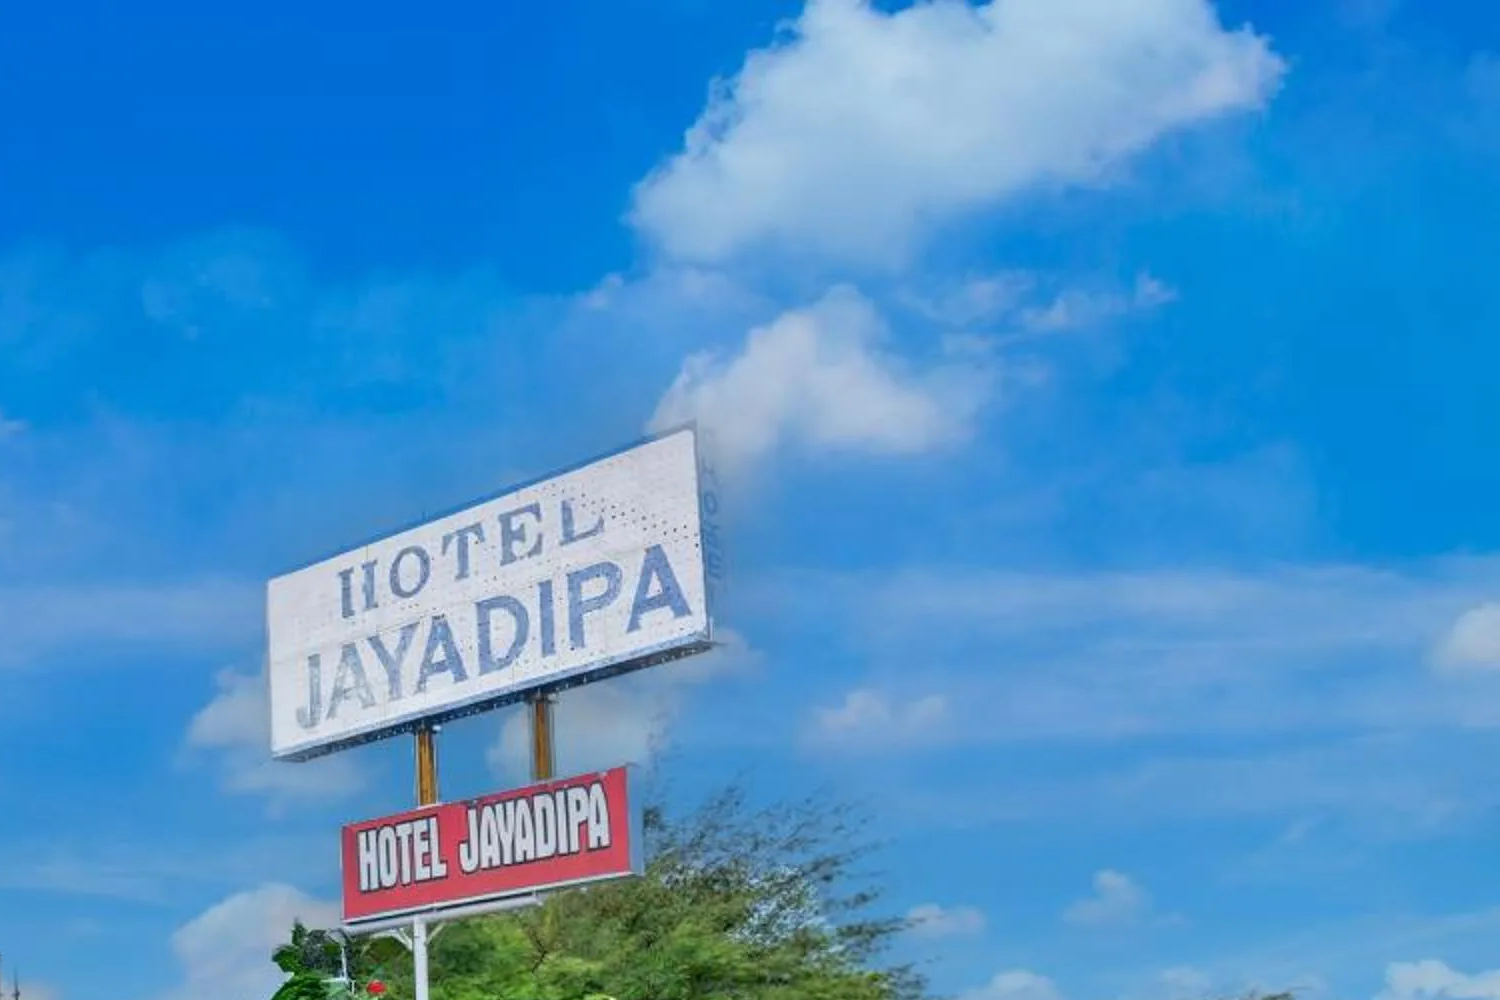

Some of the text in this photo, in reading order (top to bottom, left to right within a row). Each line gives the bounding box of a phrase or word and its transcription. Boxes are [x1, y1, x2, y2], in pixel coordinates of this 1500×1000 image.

[338, 499, 605, 619] HOTEL
[296, 543, 693, 729] JAYADIPA
[357, 781, 611, 893] HOTEL JAYADIPA
